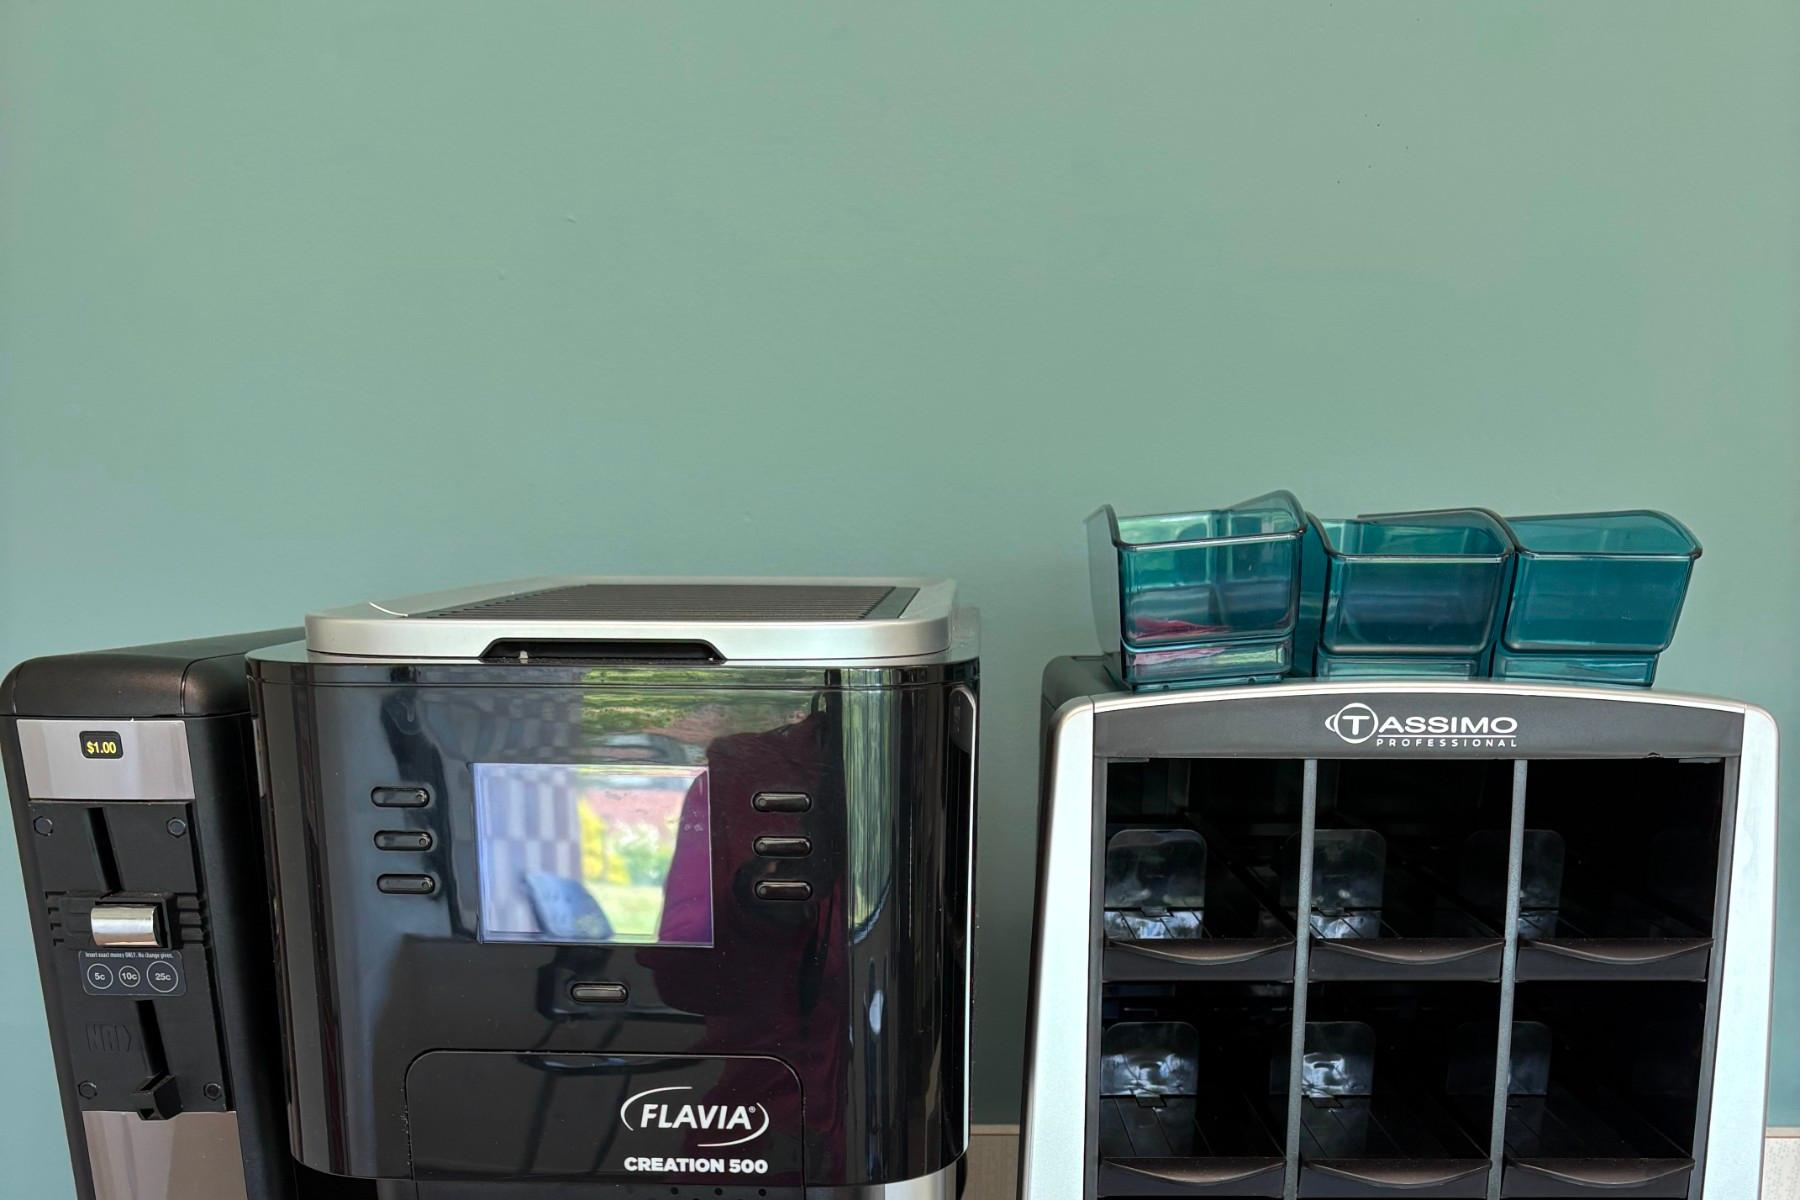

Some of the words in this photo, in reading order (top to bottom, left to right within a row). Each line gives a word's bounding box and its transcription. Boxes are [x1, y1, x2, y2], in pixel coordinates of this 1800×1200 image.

[1342, 715, 1518, 735] TASSIMO
[86, 740, 117, 754] $1.00
[1376, 738, 1517, 747] PROFESSIONAL
[94, 972, 106, 981] 5c
[121, 972, 138, 981] 10c
[154, 972, 172, 981] 25c
[623, 1156, 726, 1173] CREATION
[729, 1158, 769, 1174] 500
